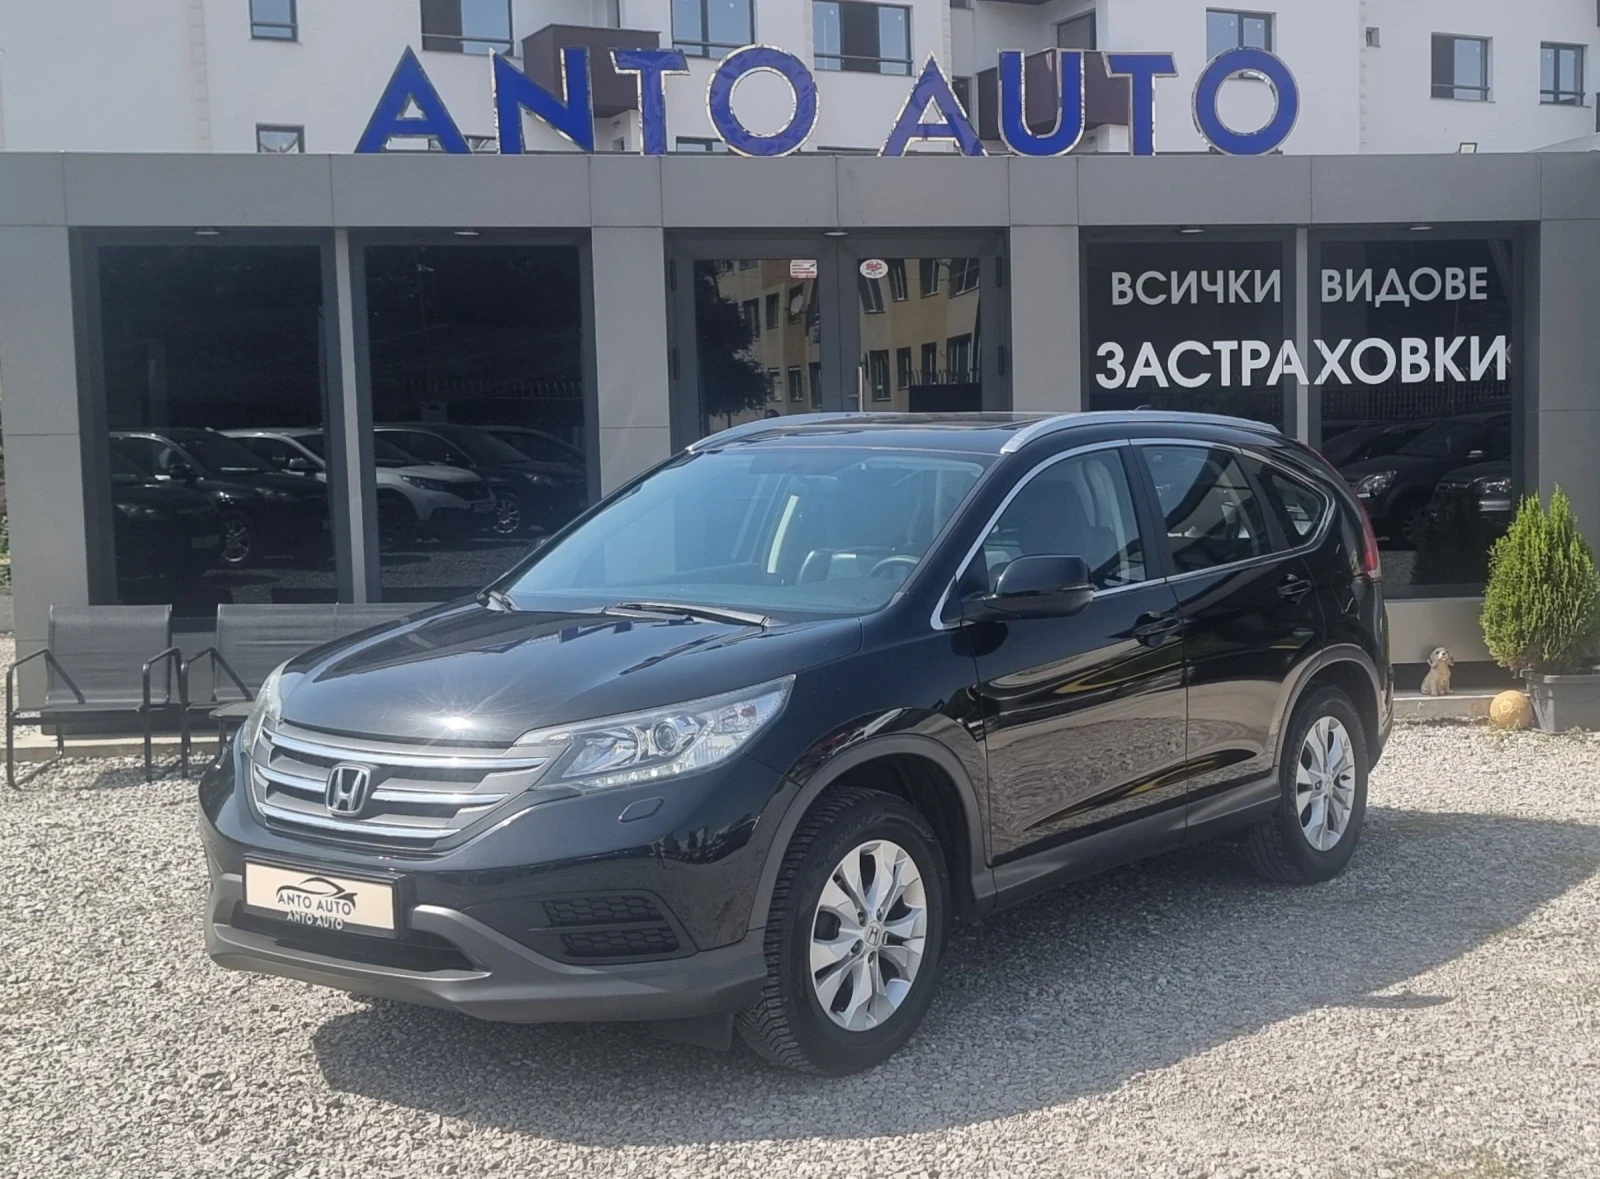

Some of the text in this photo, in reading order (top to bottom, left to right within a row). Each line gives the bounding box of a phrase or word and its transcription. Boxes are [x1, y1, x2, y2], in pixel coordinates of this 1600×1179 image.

[354, 44, 1300, 156] ANTO AUTO
[1111, 267, 1488, 307] ВСИЧКИ ВИДОВЕ
[1095, 335, 1507, 389] ЗАСТРАХОВКИ
[278, 892, 352, 916] ANTO AUTO
[286, 910, 344, 930] ANTO AUTO
